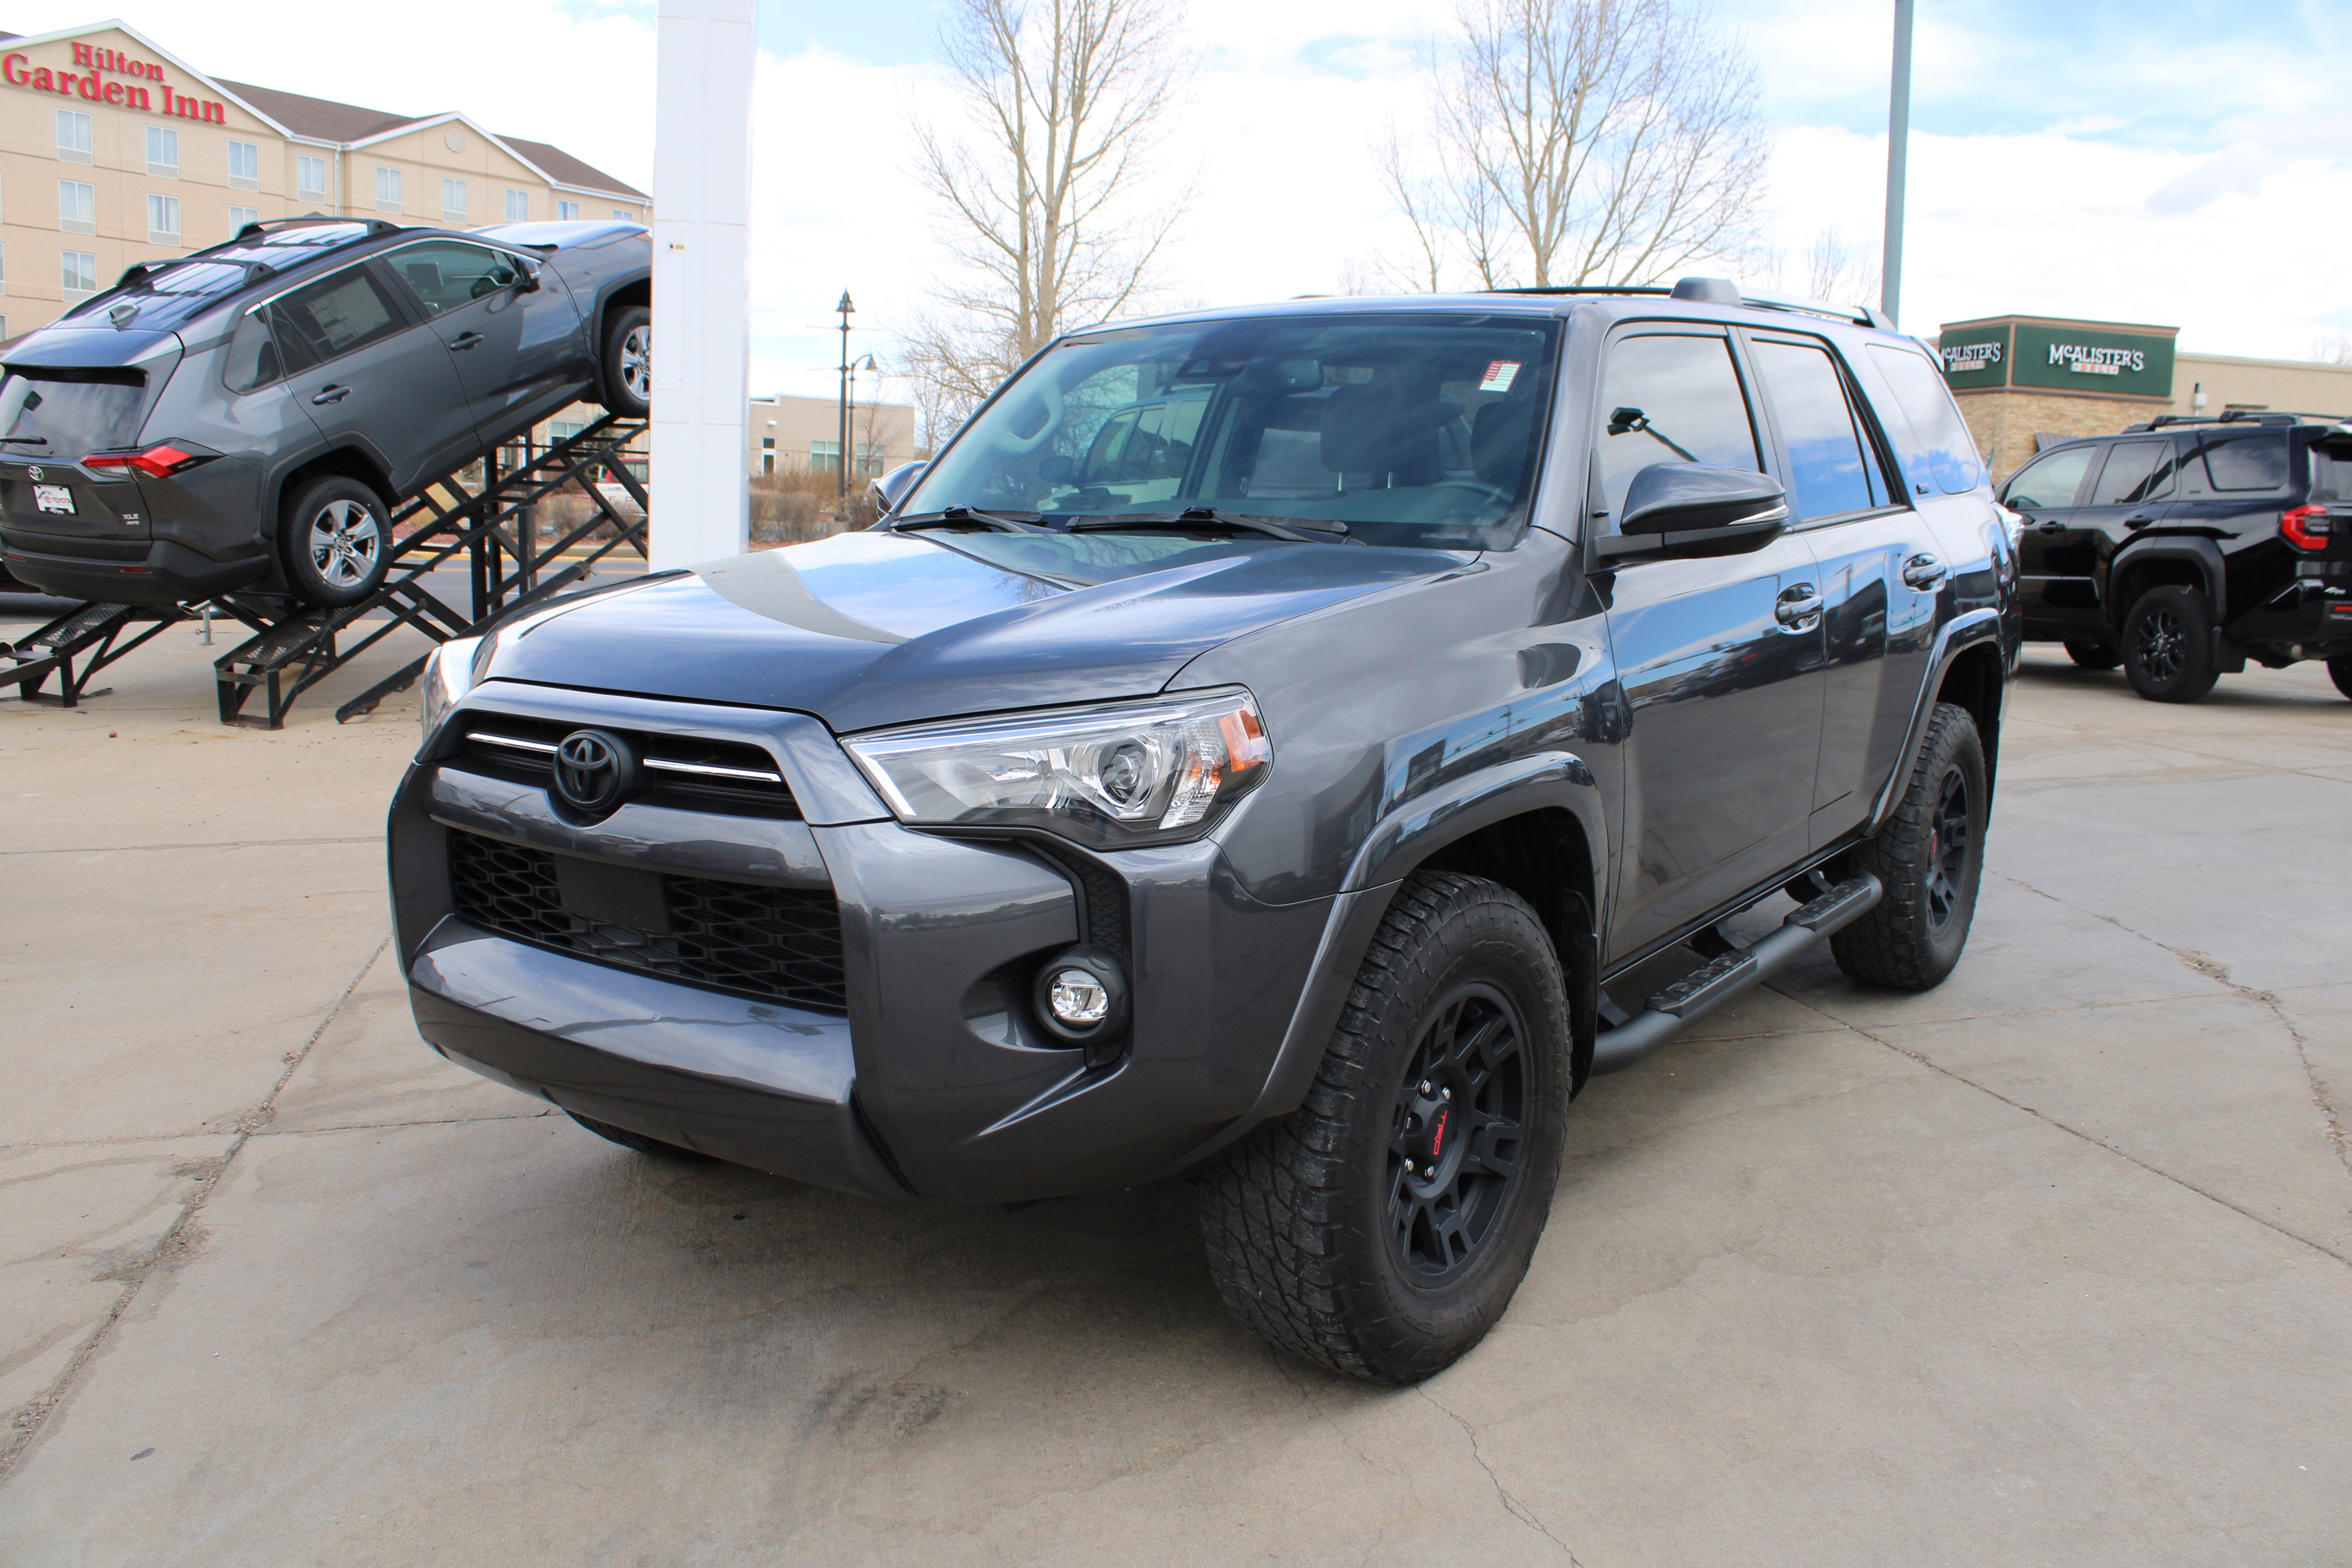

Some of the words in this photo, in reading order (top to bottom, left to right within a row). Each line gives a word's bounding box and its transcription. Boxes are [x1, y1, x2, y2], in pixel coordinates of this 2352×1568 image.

[72, 42, 165, 81] Hilton
[3, 53, 151, 110] Garden
[162, 85, 227, 124] Inn
[1433, 1110, 1448, 1156] TRD
